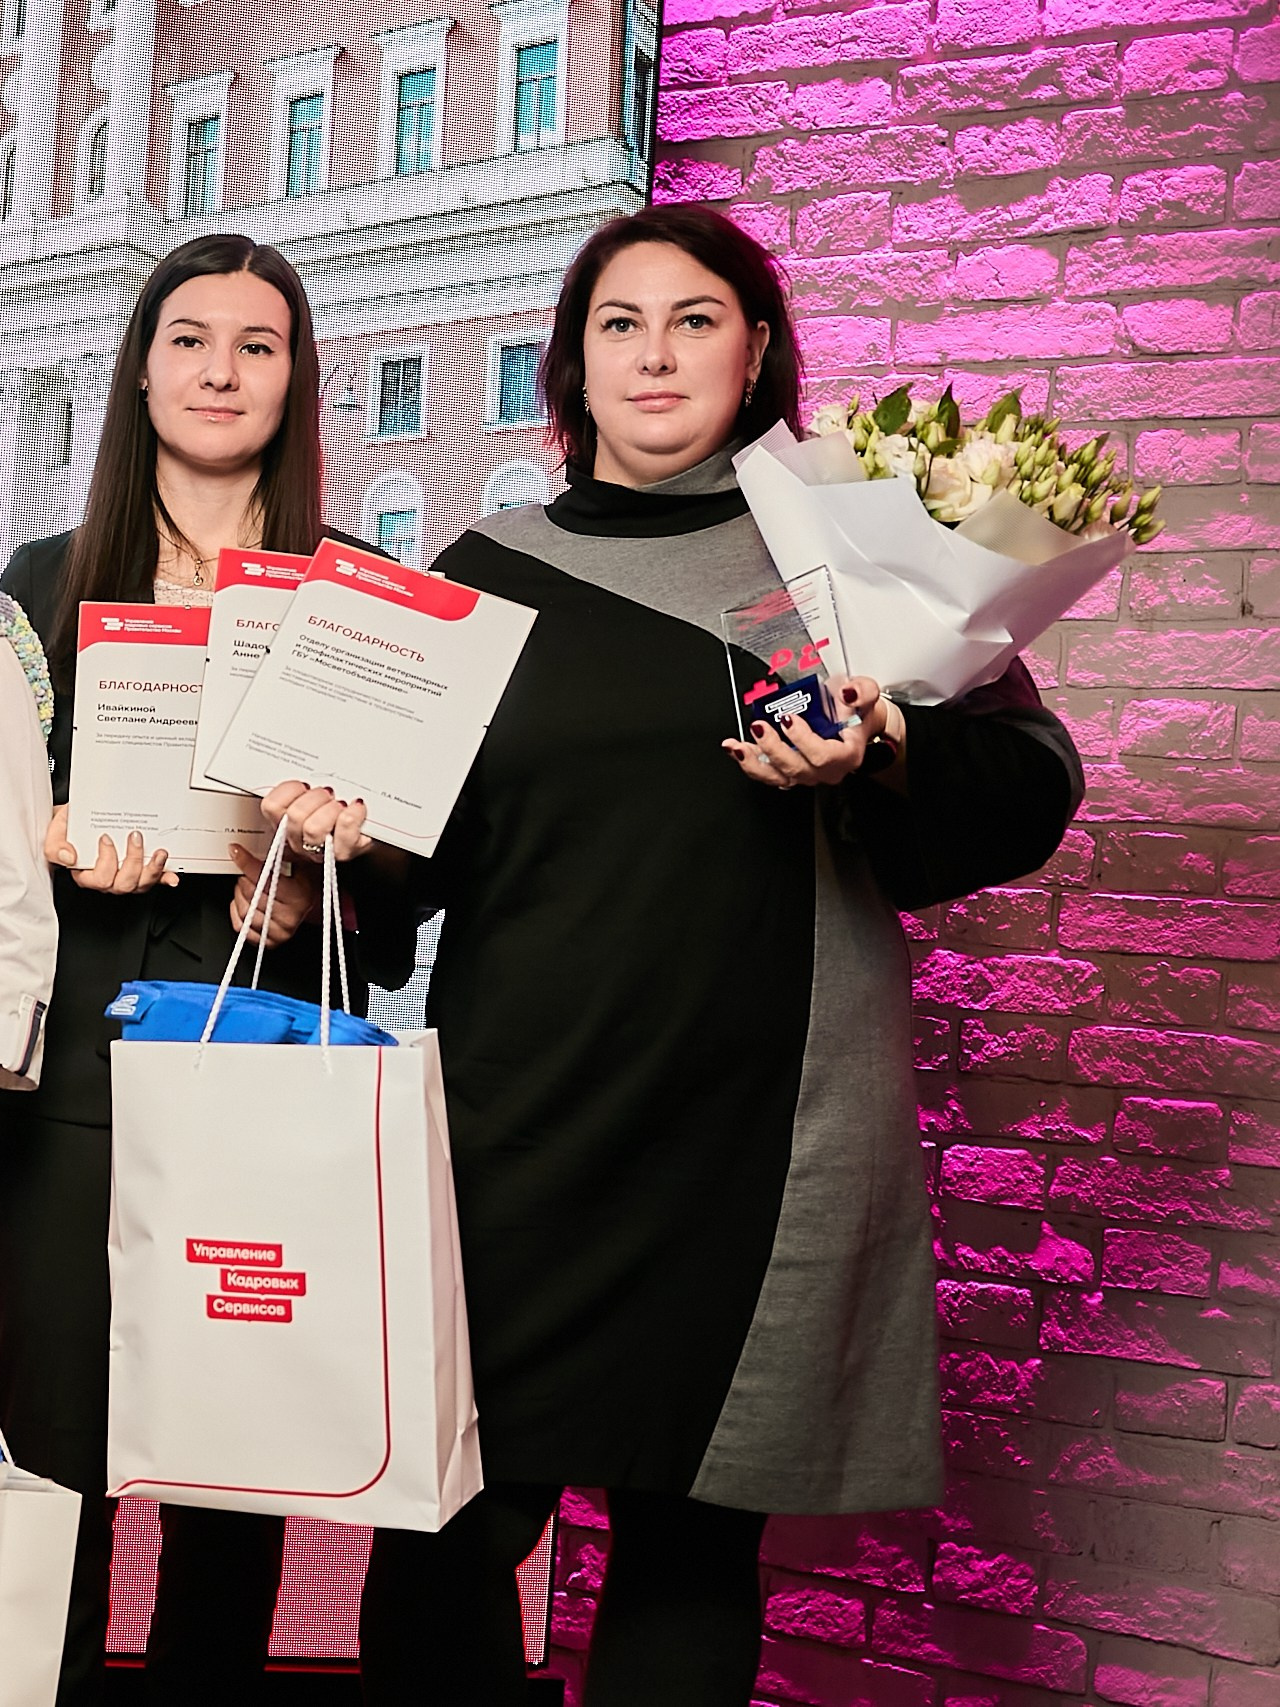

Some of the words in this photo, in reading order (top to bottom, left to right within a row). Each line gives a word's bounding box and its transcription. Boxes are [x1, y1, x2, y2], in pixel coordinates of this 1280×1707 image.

[308, 615, 425, 663] БЛАГОДАРНОСТЬ
[232, 650, 260, 659] Анне
[291, 649, 309, 660] ГБУ
[299, 634, 330, 650] Отделу
[331, 645, 385, 669] организации
[386, 665, 448, 690] ветеринарных
[302, 645, 383, 677] профилактических
[384, 673, 442, 697] мероприятий
[97, 703, 156, 713] Ивайкиной
[97, 714, 147, 723] Светлане
[192, 1242, 276, 1261] Управление
[227, 1272, 299, 1290] Кадровых
[212, 1298, 285, 1316] Сервисов
